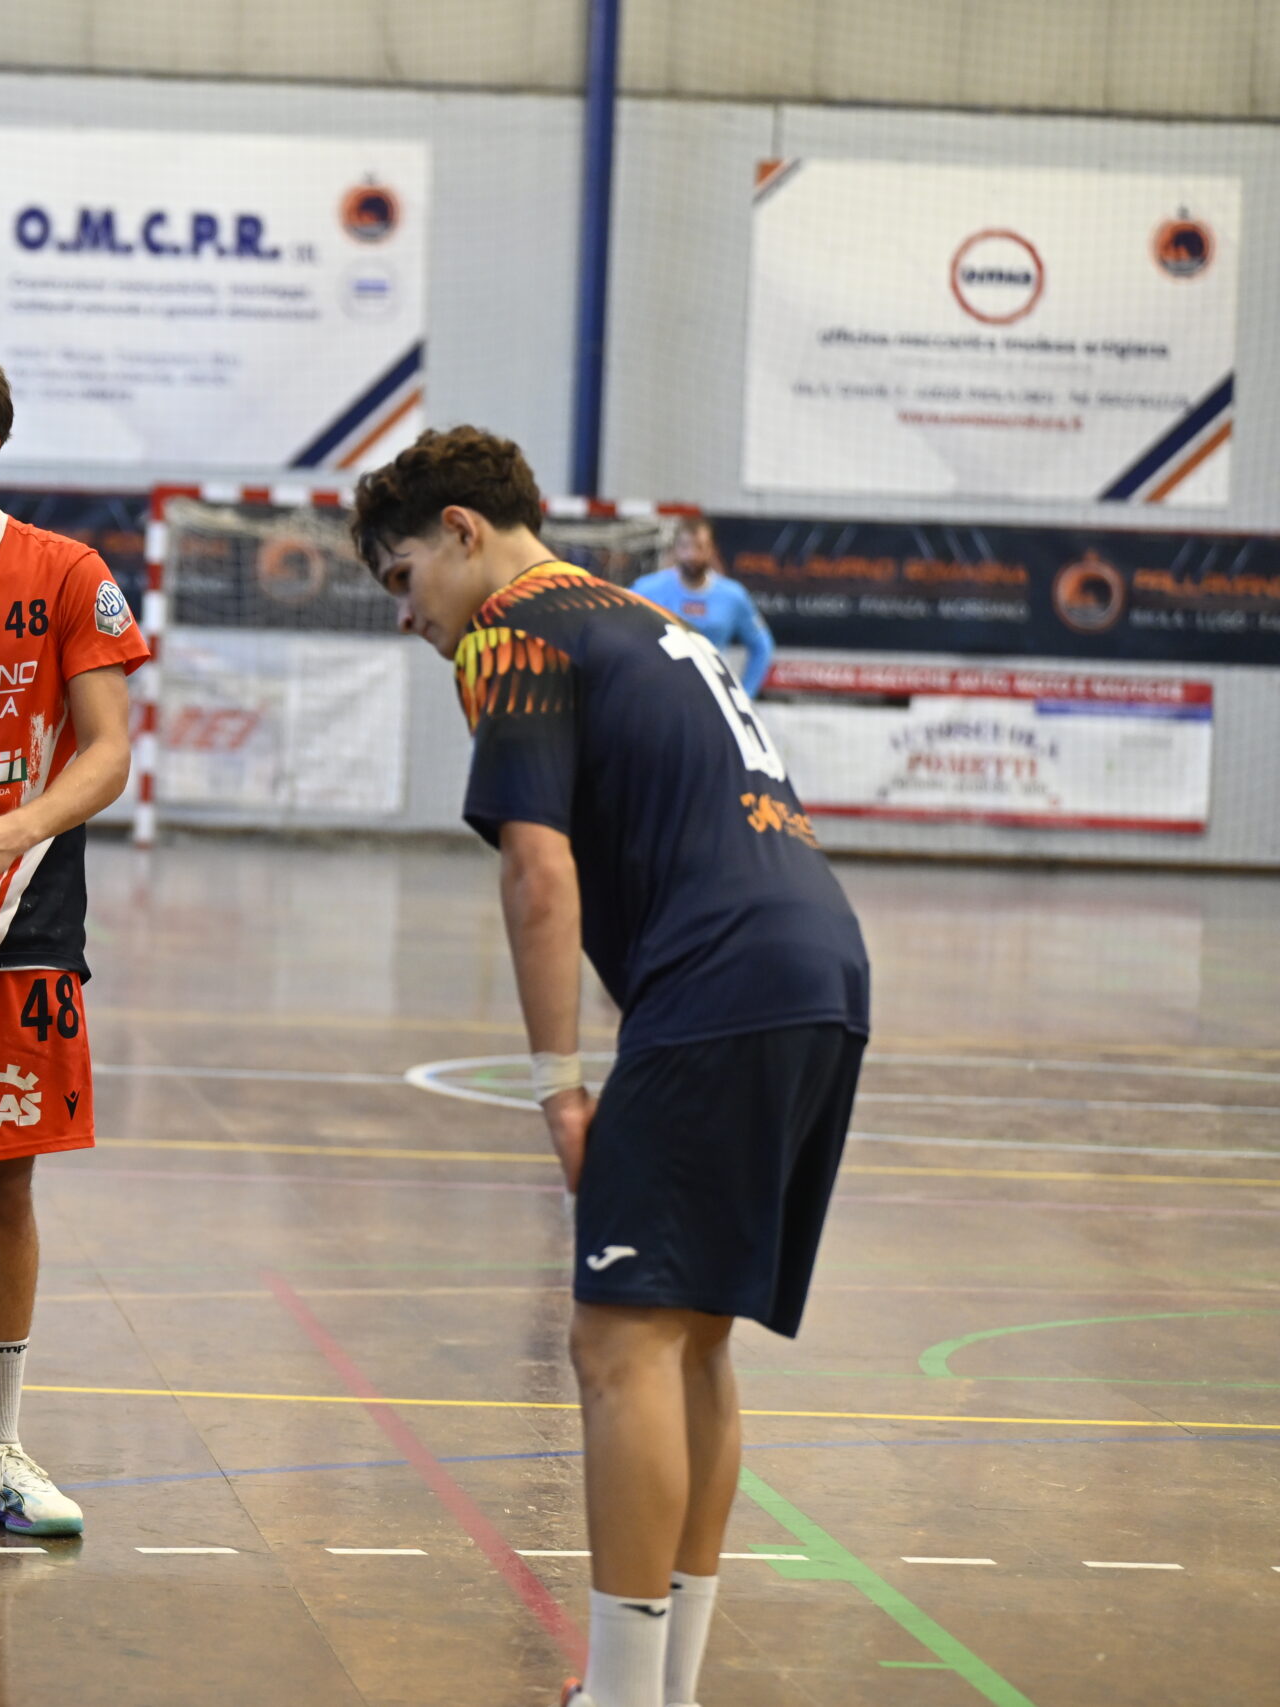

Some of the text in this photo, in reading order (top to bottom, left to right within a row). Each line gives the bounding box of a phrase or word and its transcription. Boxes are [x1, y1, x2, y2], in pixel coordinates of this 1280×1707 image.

[14, 207, 283, 262] O.M.C.P.R.
[5, 599, 49, 638] 48
[21, 974, 79, 1042] 48
